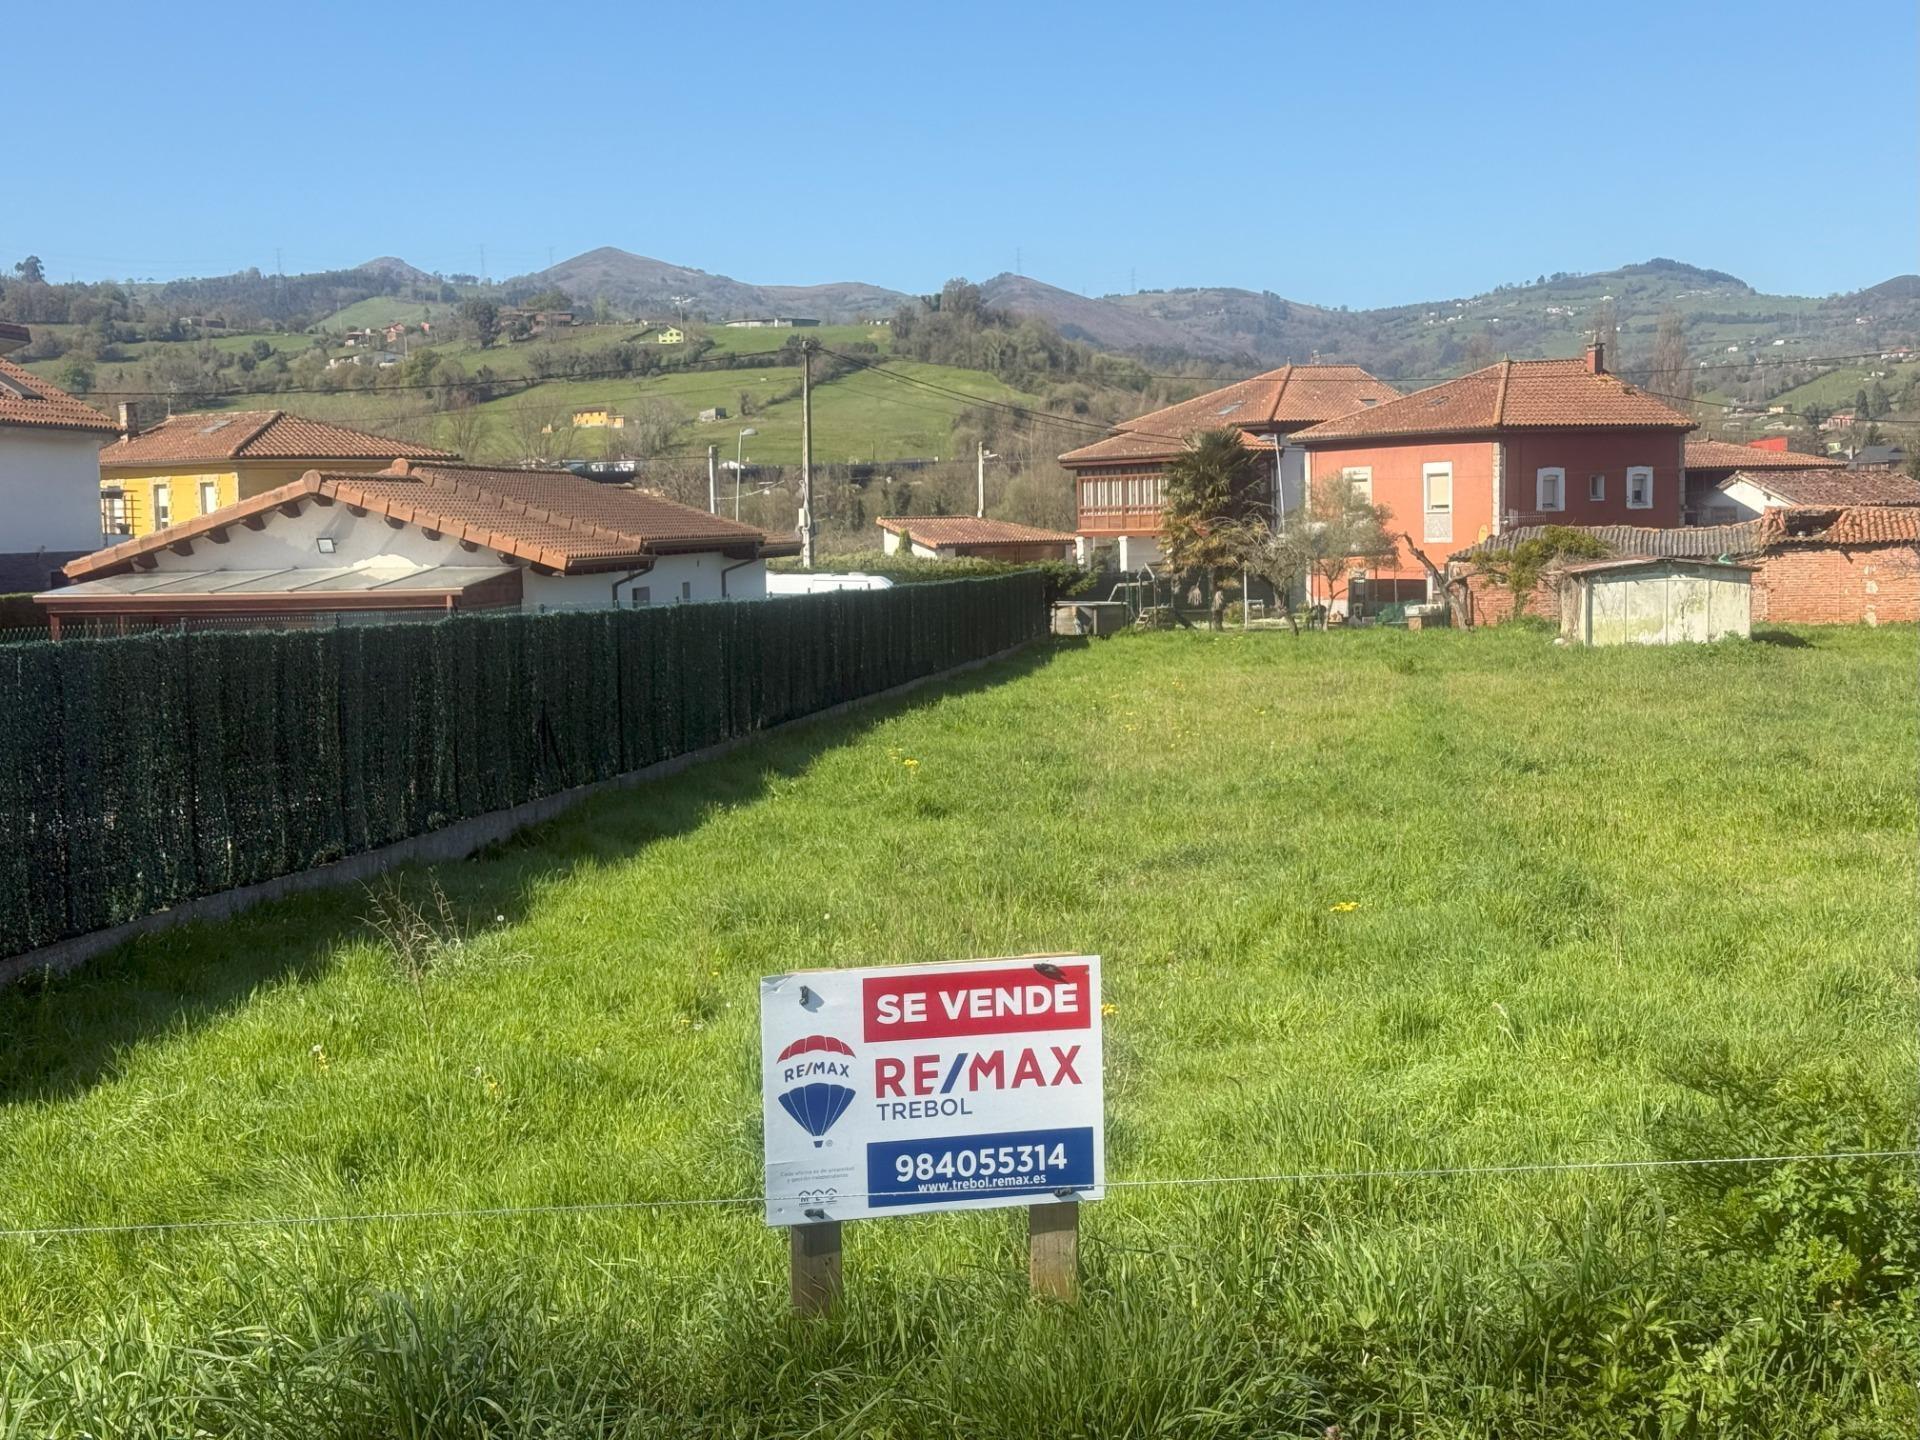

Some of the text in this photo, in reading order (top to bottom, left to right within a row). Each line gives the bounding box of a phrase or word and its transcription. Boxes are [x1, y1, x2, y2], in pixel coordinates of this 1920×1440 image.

[876, 983, 1078, 1025] SE VENDE
[784, 1061, 850, 1083] RE/MAX
[875, 1045, 1083, 1099] RE/MAX
[876, 1098, 973, 1121] TREBOL
[895, 1143, 1068, 1182] 984055314
[917, 1173, 1047, 1193] www.trebol.remax.es
